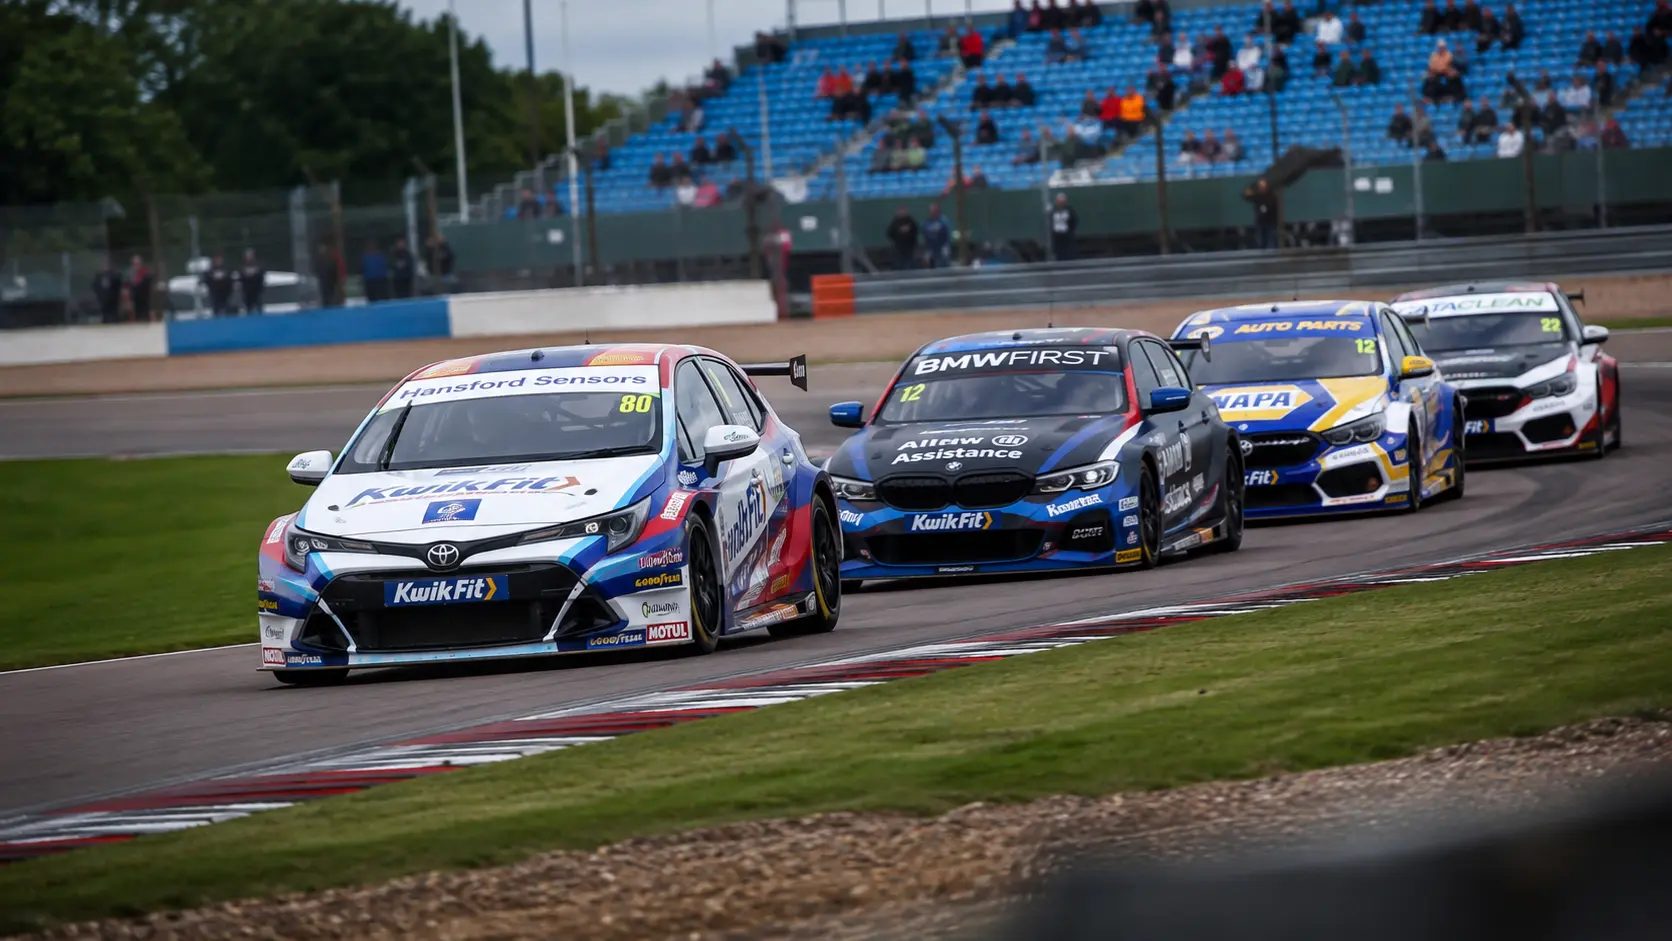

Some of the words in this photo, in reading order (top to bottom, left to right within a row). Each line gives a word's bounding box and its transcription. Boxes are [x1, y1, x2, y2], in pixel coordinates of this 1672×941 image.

[1402, 298, 1543, 314] ATACLEAN
[1234, 322, 1292, 334] AUTO
[1296, 320, 1364, 331] PARTS
[1541, 318, 1561, 332] 22
[1355, 339, 1376, 353] 12
[914, 350, 1109, 375] BMWFIRST
[400, 377, 526, 399] Hansford
[534, 375, 647, 386] Sensors
[900, 384, 926, 402] 12
[619, 394, 652, 413] 80
[1213, 391, 1290, 409] NAPA
[891, 448, 1023, 465] Assistance
[648, 623, 687, 640] MOTUL
